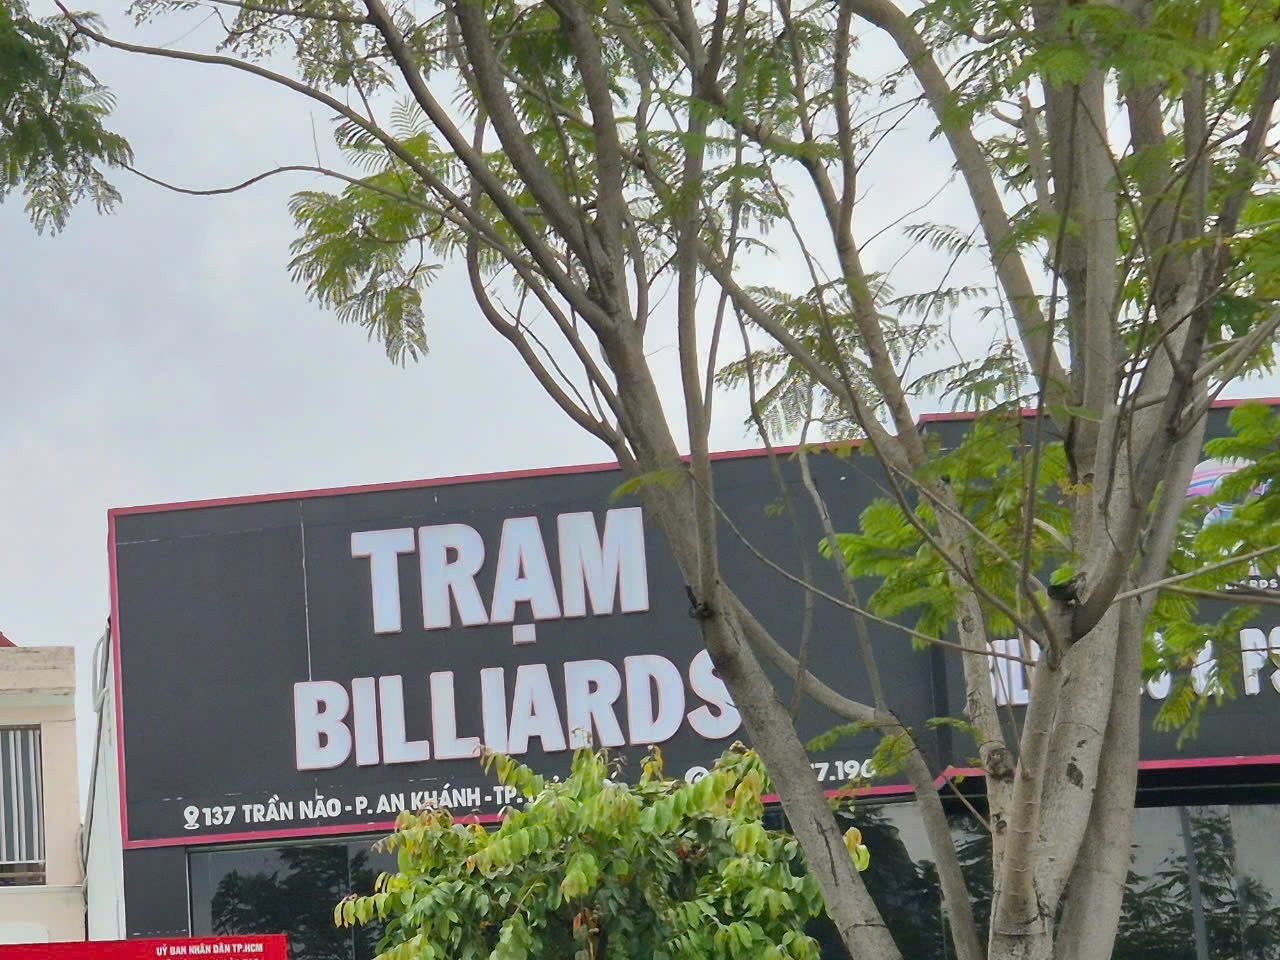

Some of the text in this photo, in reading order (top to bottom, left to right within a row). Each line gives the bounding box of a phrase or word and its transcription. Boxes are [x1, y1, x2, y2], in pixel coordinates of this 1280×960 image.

[350, 506, 650, 645] TRẠM
[293, 648, 743, 772] BILLIARDS
[201, 806, 235, 828] 137
[242, 794, 294, 823] TRẦN
[299, 796, 341, 821] NÃO
[376, 792, 407, 814] AN
[410, 783, 481, 811] KHÁNH
[169, 946, 187, 955] BAN
[189, 943, 211, 954] NHÂN
